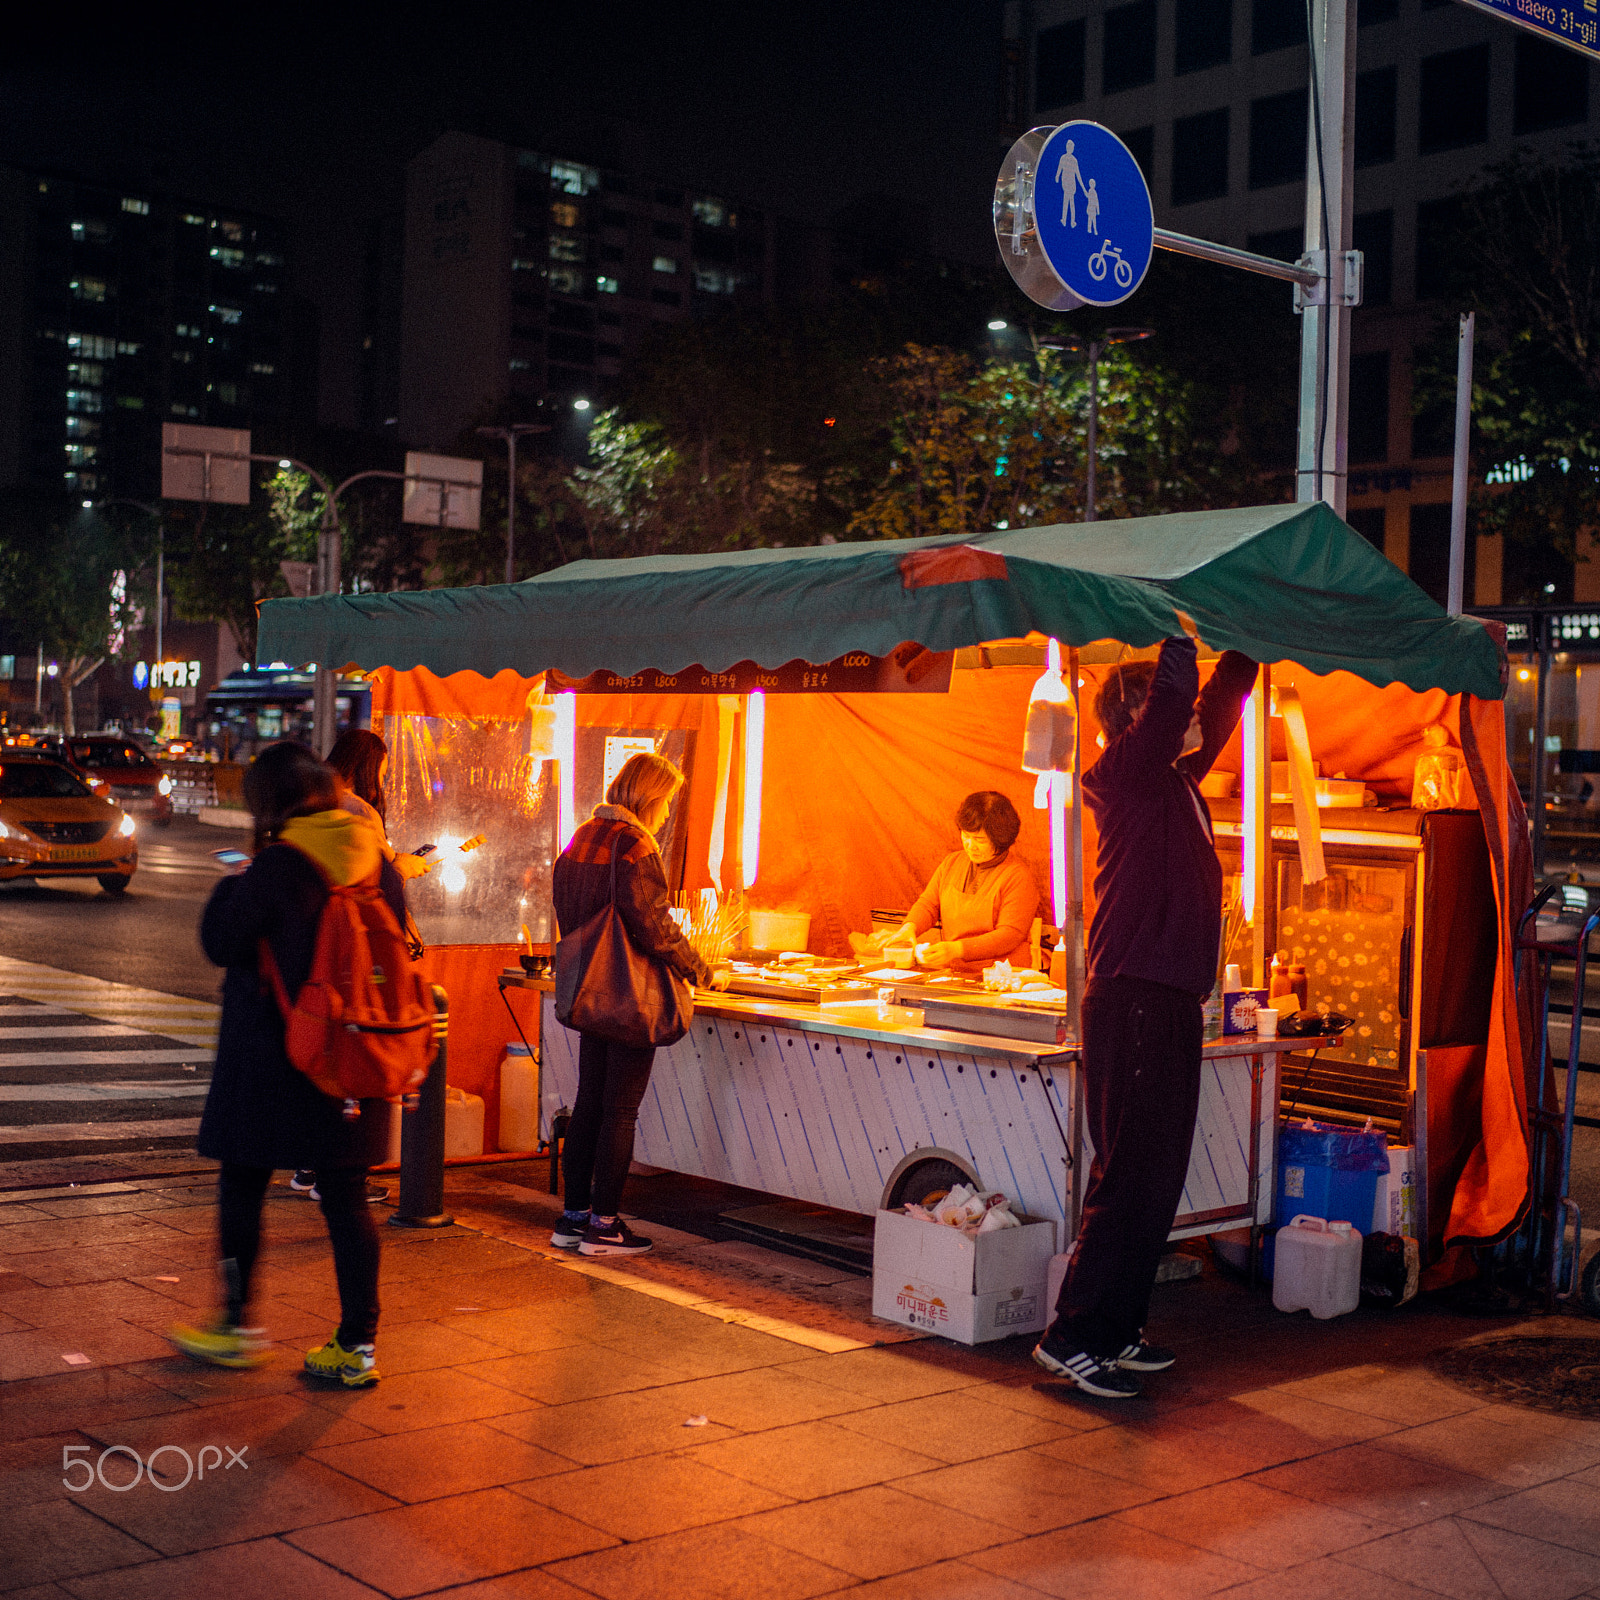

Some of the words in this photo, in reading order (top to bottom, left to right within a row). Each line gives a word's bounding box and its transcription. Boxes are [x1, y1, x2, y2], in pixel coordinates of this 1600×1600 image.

[1560, 8, 1598, 44] 31-gil
[802, 672, 828, 688] 음료수
[896, 1295, 949, 1321] 미니파운드
